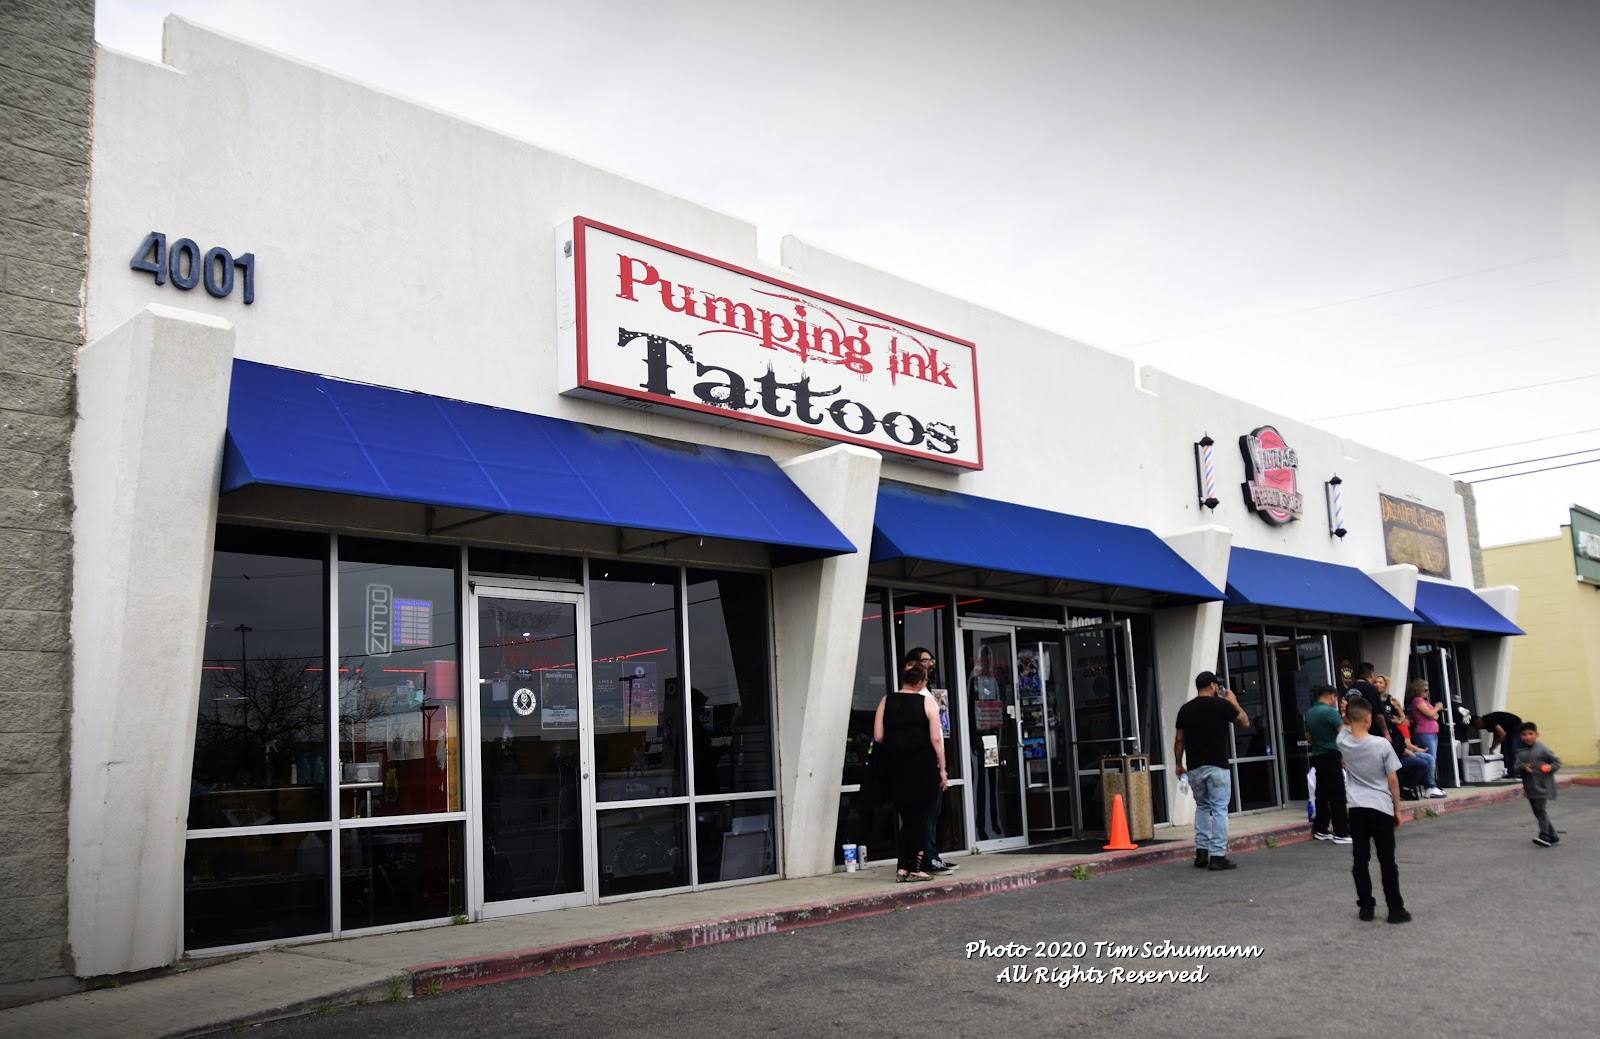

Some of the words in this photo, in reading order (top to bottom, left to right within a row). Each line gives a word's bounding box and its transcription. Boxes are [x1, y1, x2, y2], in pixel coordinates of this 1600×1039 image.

[130, 231, 255, 305] 4001
[616, 253, 874, 375] Pumping
[617, 326, 960, 454] Tattoos
[371, 589, 388, 653] OPEN
[691, 920, 730, 945] FIRE
[735, 913, 777, 937] LANE
